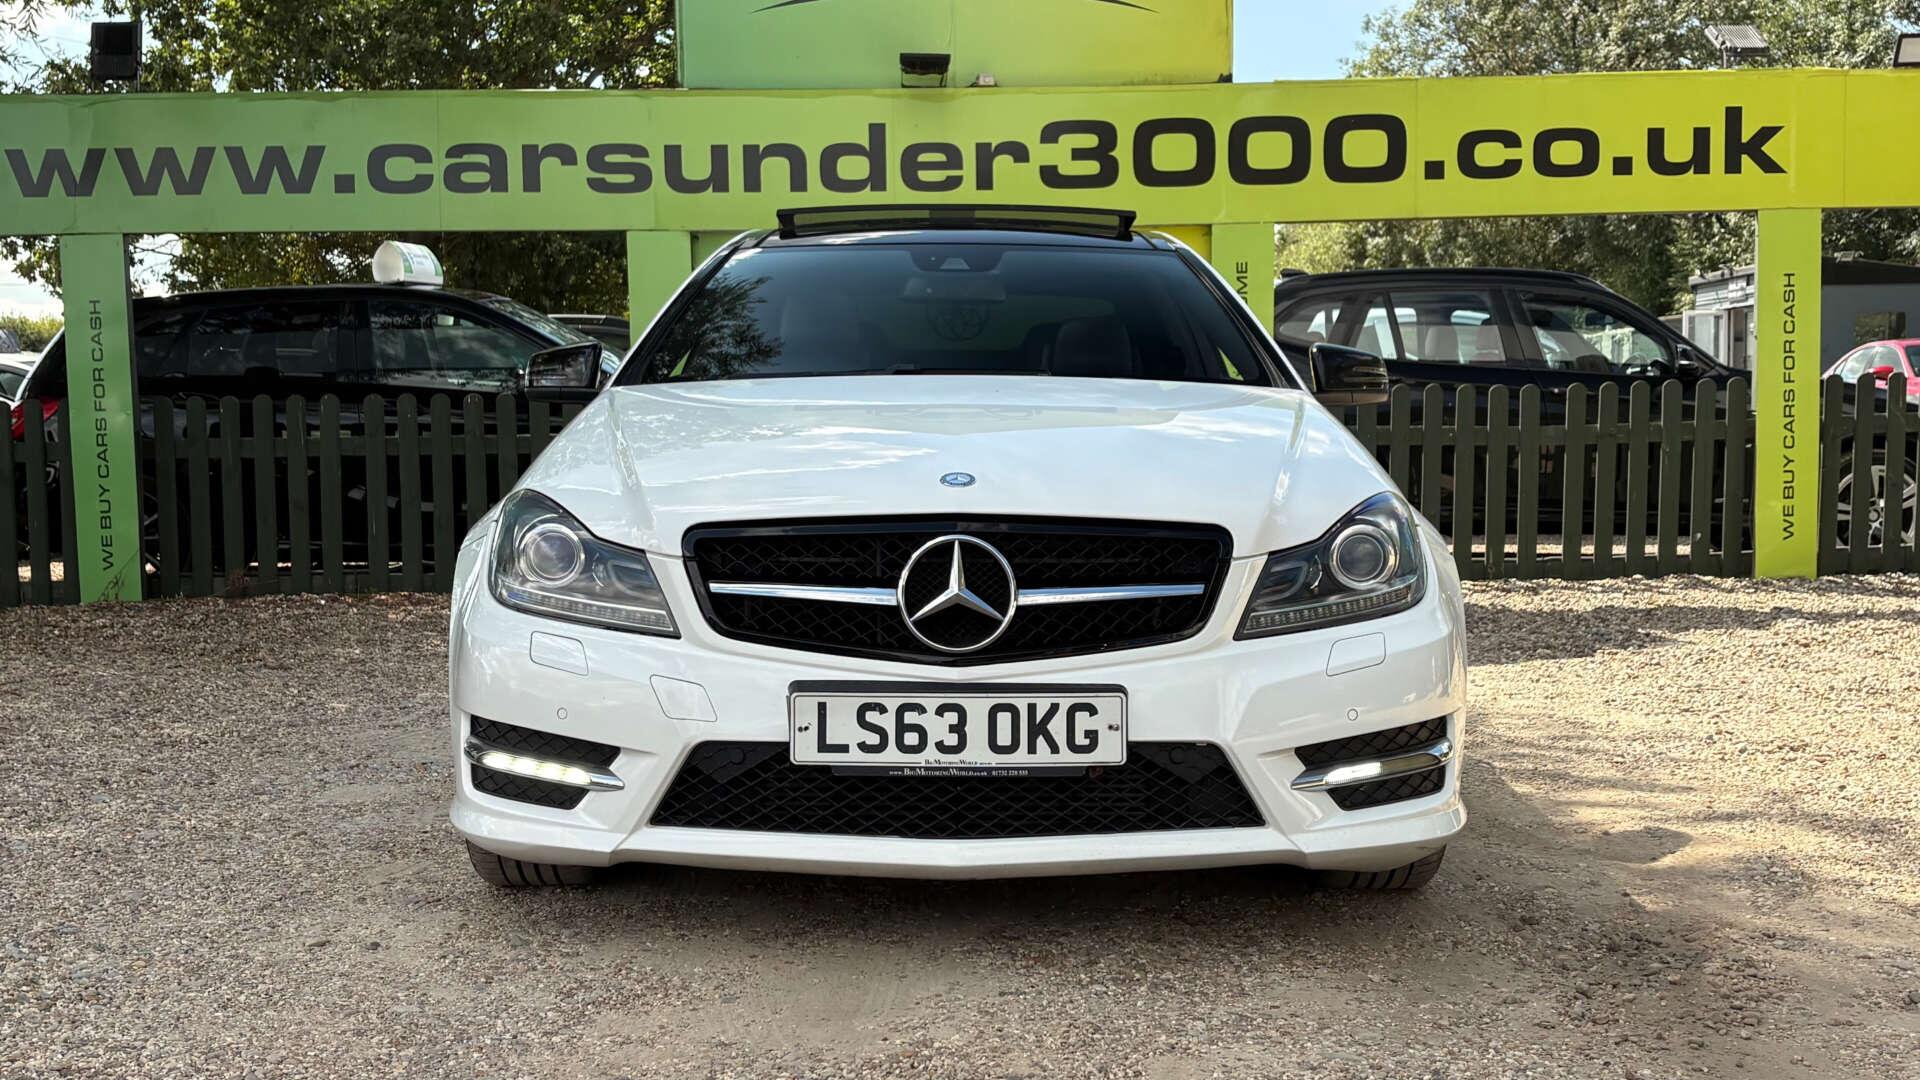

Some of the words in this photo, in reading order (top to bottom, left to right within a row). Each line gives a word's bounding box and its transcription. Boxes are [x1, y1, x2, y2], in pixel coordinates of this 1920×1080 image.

[4, 105, 1787, 198] www.carsunder3000.co.uk
[1783, 273, 1795, 334] CASH
[89, 299, 104, 362] CASH
[1783, 339, 1795, 383] FOR
[93, 367, 106, 412] FOR
[1783, 388, 1795, 449] CARS
[95, 417, 110, 479] CARS
[1783, 454, 1795, 500] BUY
[97, 483, 112, 530] BUY
[1783, 505, 1795, 541] WE
[101, 534, 115, 572] WE
[817, 701, 968, 755] LS63
